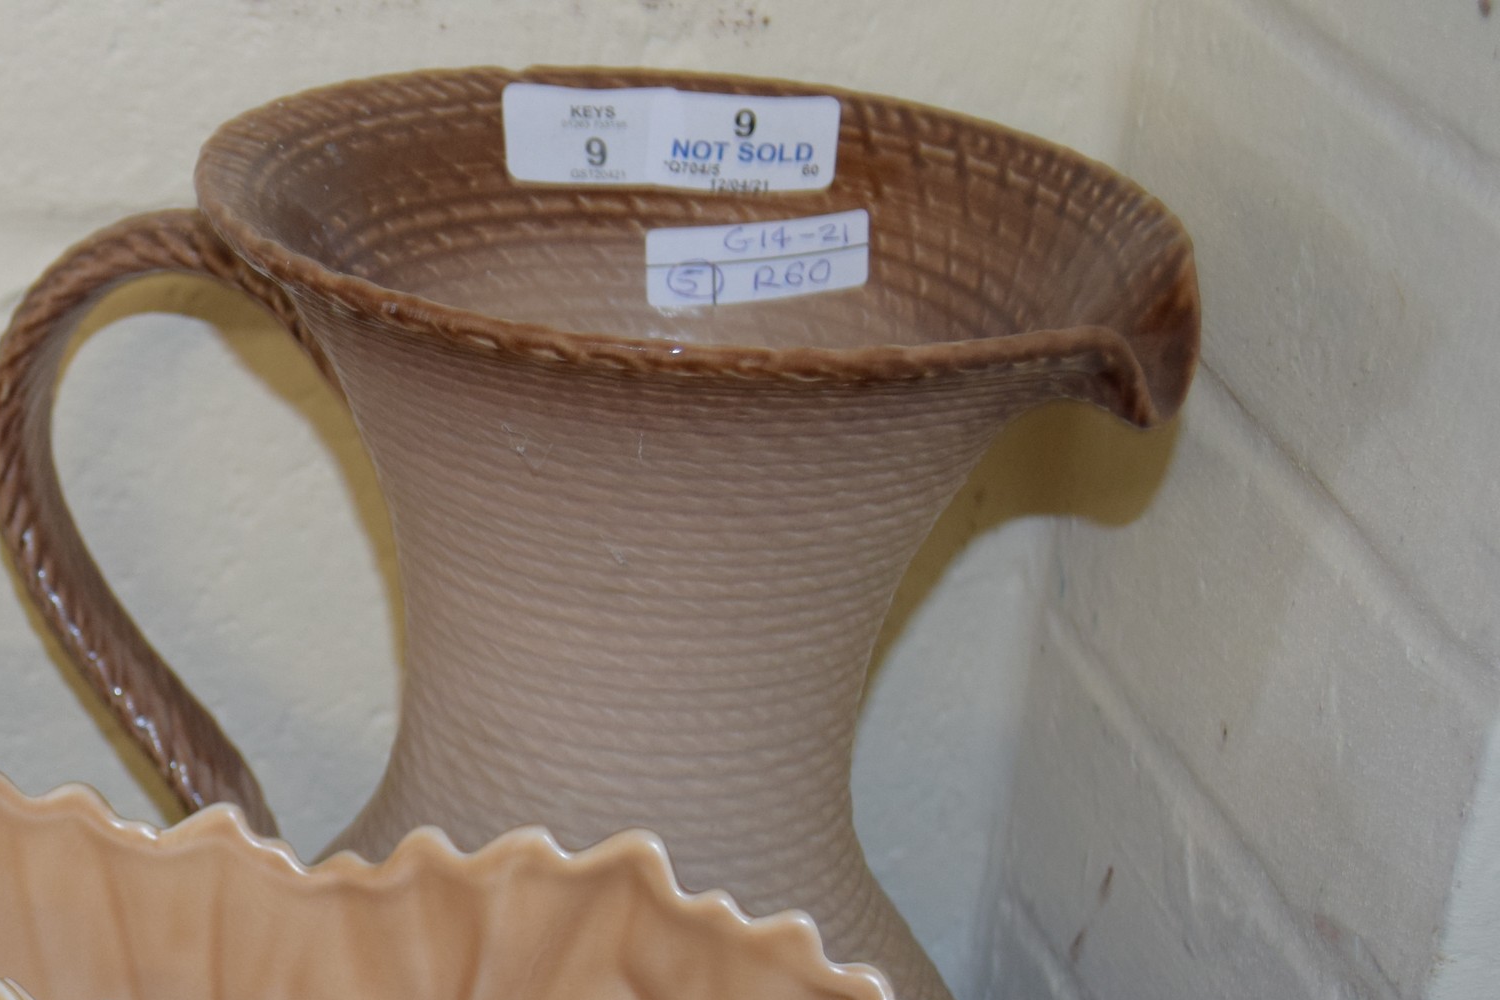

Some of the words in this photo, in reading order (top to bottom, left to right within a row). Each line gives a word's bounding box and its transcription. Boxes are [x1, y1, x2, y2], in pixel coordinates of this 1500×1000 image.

[570, 104, 616, 119] KEYS
[734, 107, 757, 138] 9
[585, 136, 608, 167] 9
[672, 138, 729, 161] NOT
[737, 142, 814, 163] SOLD
[802, 164, 820, 176] 60
[754, 258, 831, 291] R60
